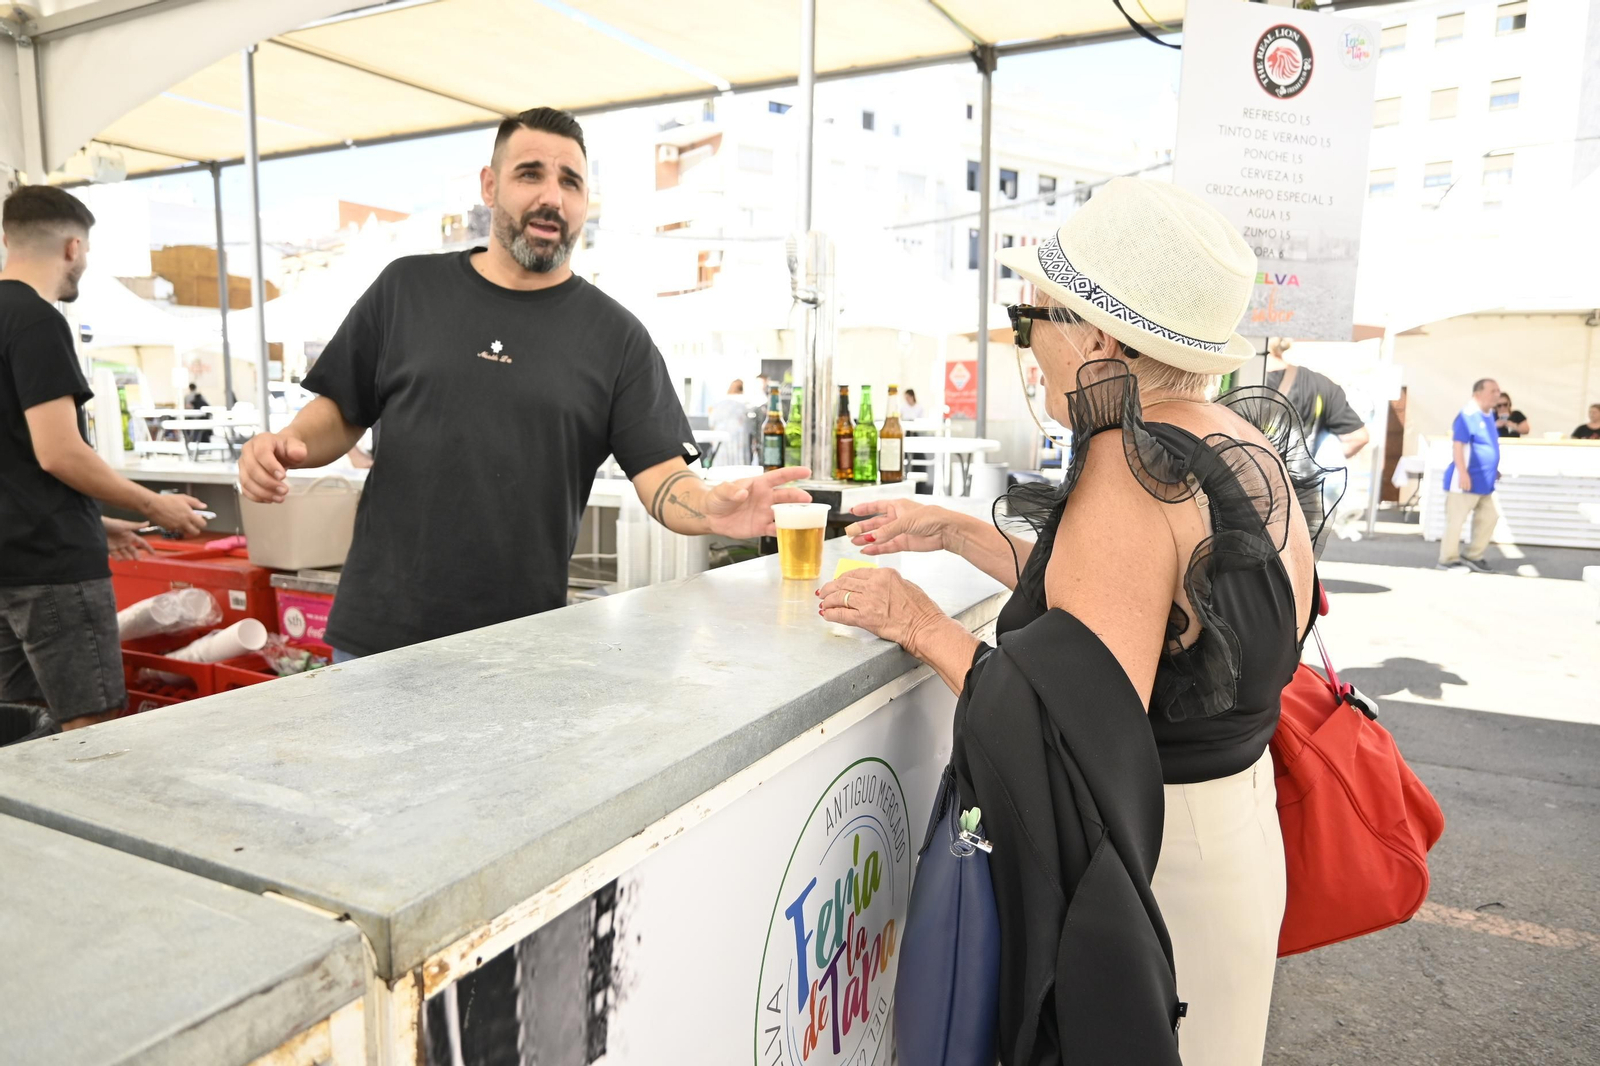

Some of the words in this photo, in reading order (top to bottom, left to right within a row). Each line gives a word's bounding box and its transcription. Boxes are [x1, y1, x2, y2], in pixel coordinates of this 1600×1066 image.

[1257, 33, 1275, 60] REAL
[1275, 28, 1300, 42] LION
[1256, 62, 1269, 87] THE
[1243, 107, 1296, 124] REFRESCO
[1218, 124, 1251, 139] TINTO
[1255, 129, 1268, 141] DE
[1272, 131, 1317, 147] VERANO
[1243, 147, 1288, 163] PONCHE
[1240, 167, 1289, 182] CERVEZA
[1205, 183, 1274, 200] CRUZCAMPO
[1277, 190, 1324, 205] ESPECIAL
[1328, 196, 1333, 206] 3
[1247, 208, 1276, 220] AGUA
[1243, 226, 1277, 239] ZUMO
[1250, 246, 1275, 258] OPA
[1279, 250, 1284, 259] 6
[1255, 272, 1300, 286] ELVA
[826, 775, 877, 837] ANTIGUO
[876, 779, 906, 864] MERCADO
[785, 833, 882, 1014] Feria
[847, 911, 868, 977] la
[818, 918, 897, 1055] Tapa
[803, 978, 829, 1061] de
[867, 996, 887, 1042] DEL
